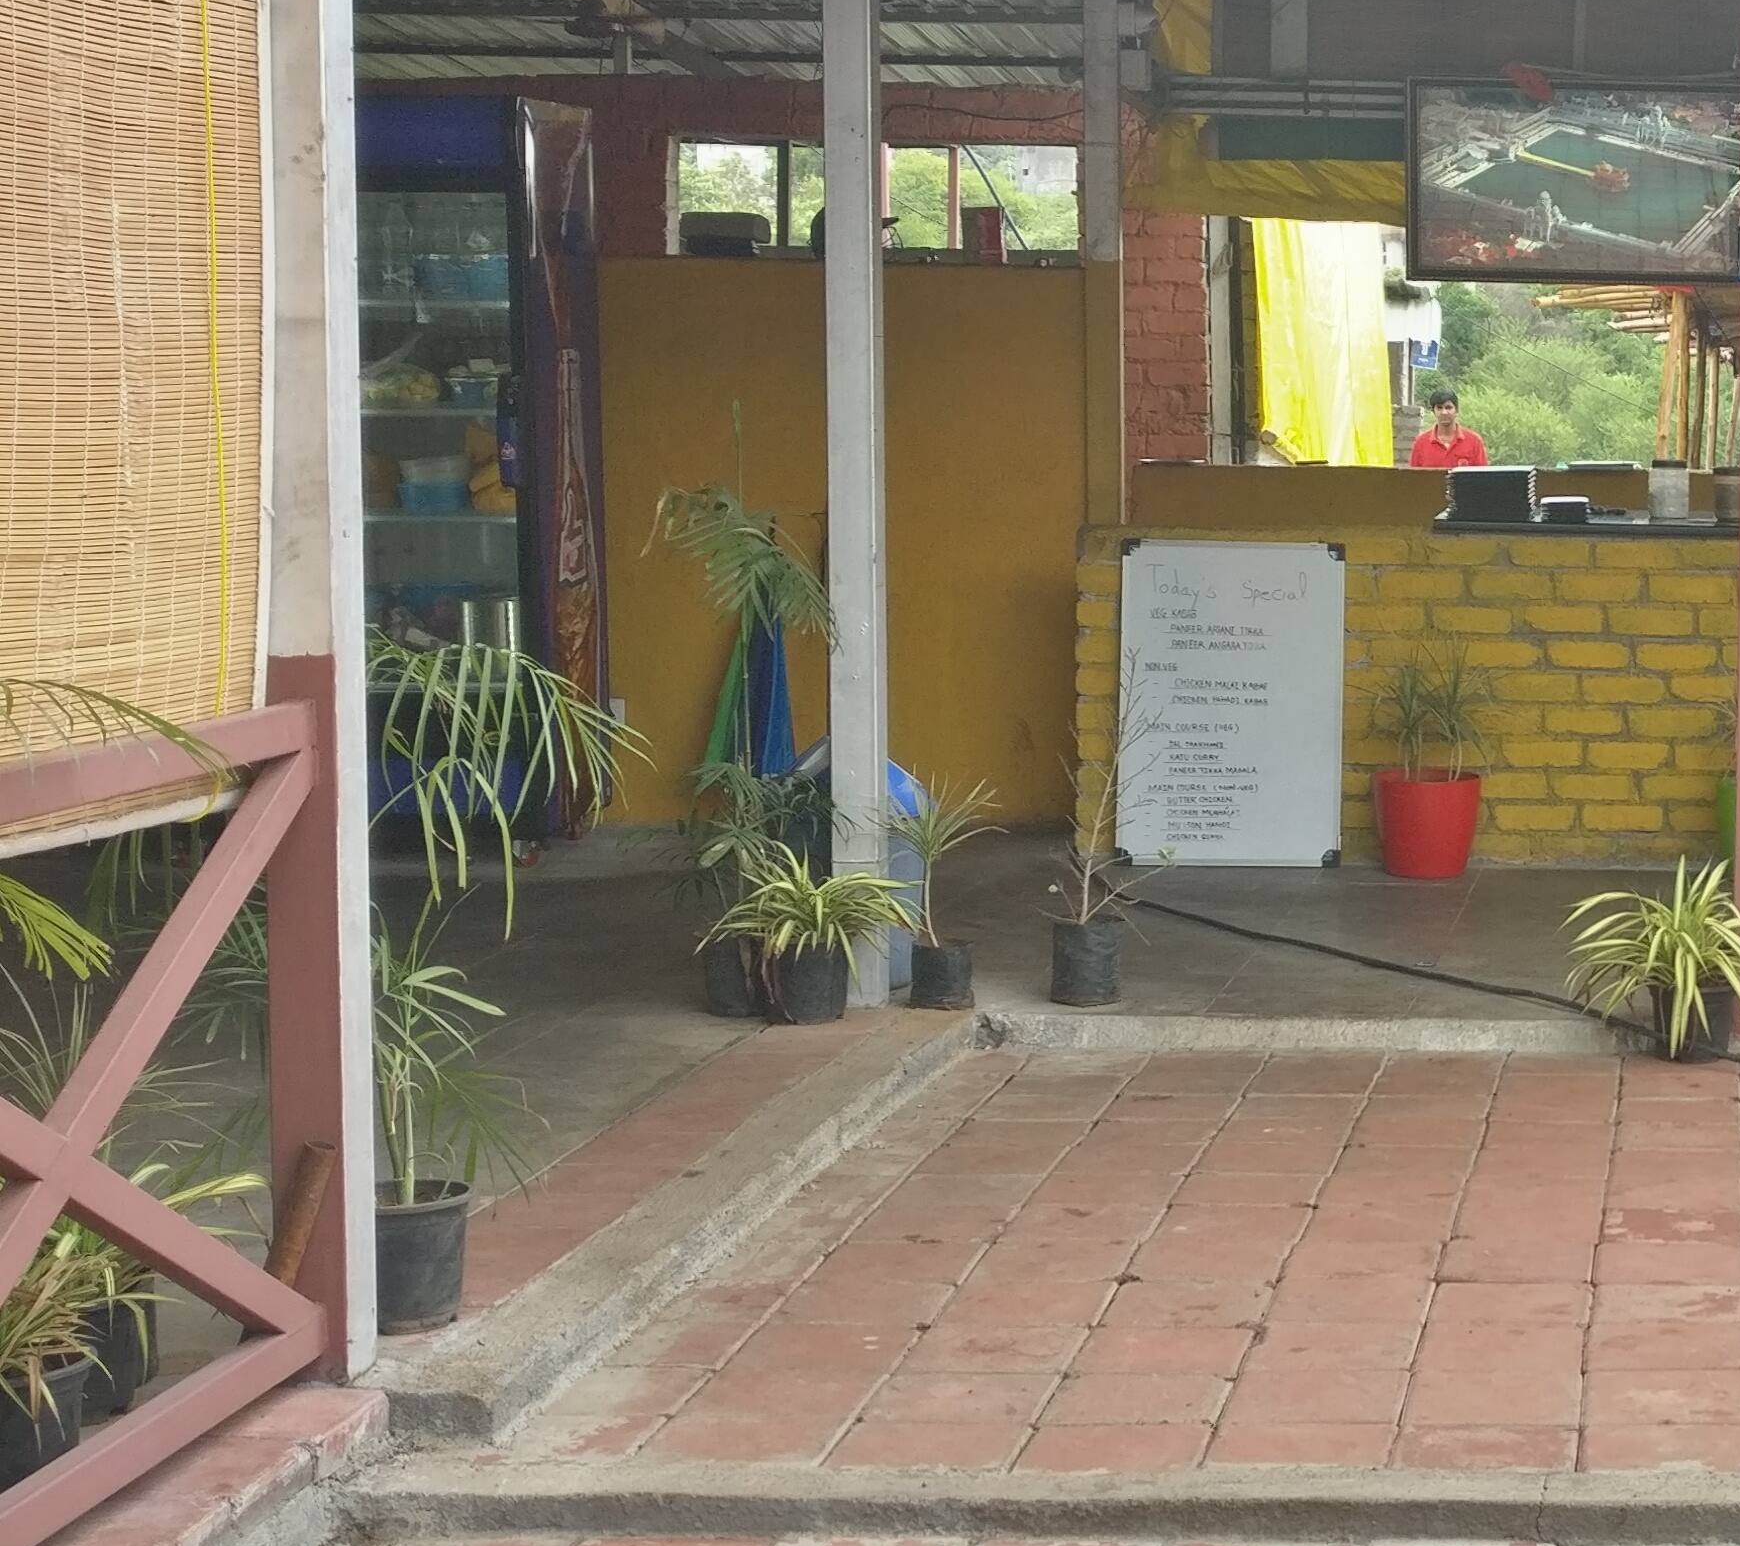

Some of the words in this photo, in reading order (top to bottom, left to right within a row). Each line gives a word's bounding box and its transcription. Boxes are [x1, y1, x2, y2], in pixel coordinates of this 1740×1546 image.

[1145, 563, 1217, 610] Today's
[1241, 571, 1308, 608] Special
[1174, 677, 1213, 689] CHICKEN
[1176, 723, 1210, 733] COURSE
